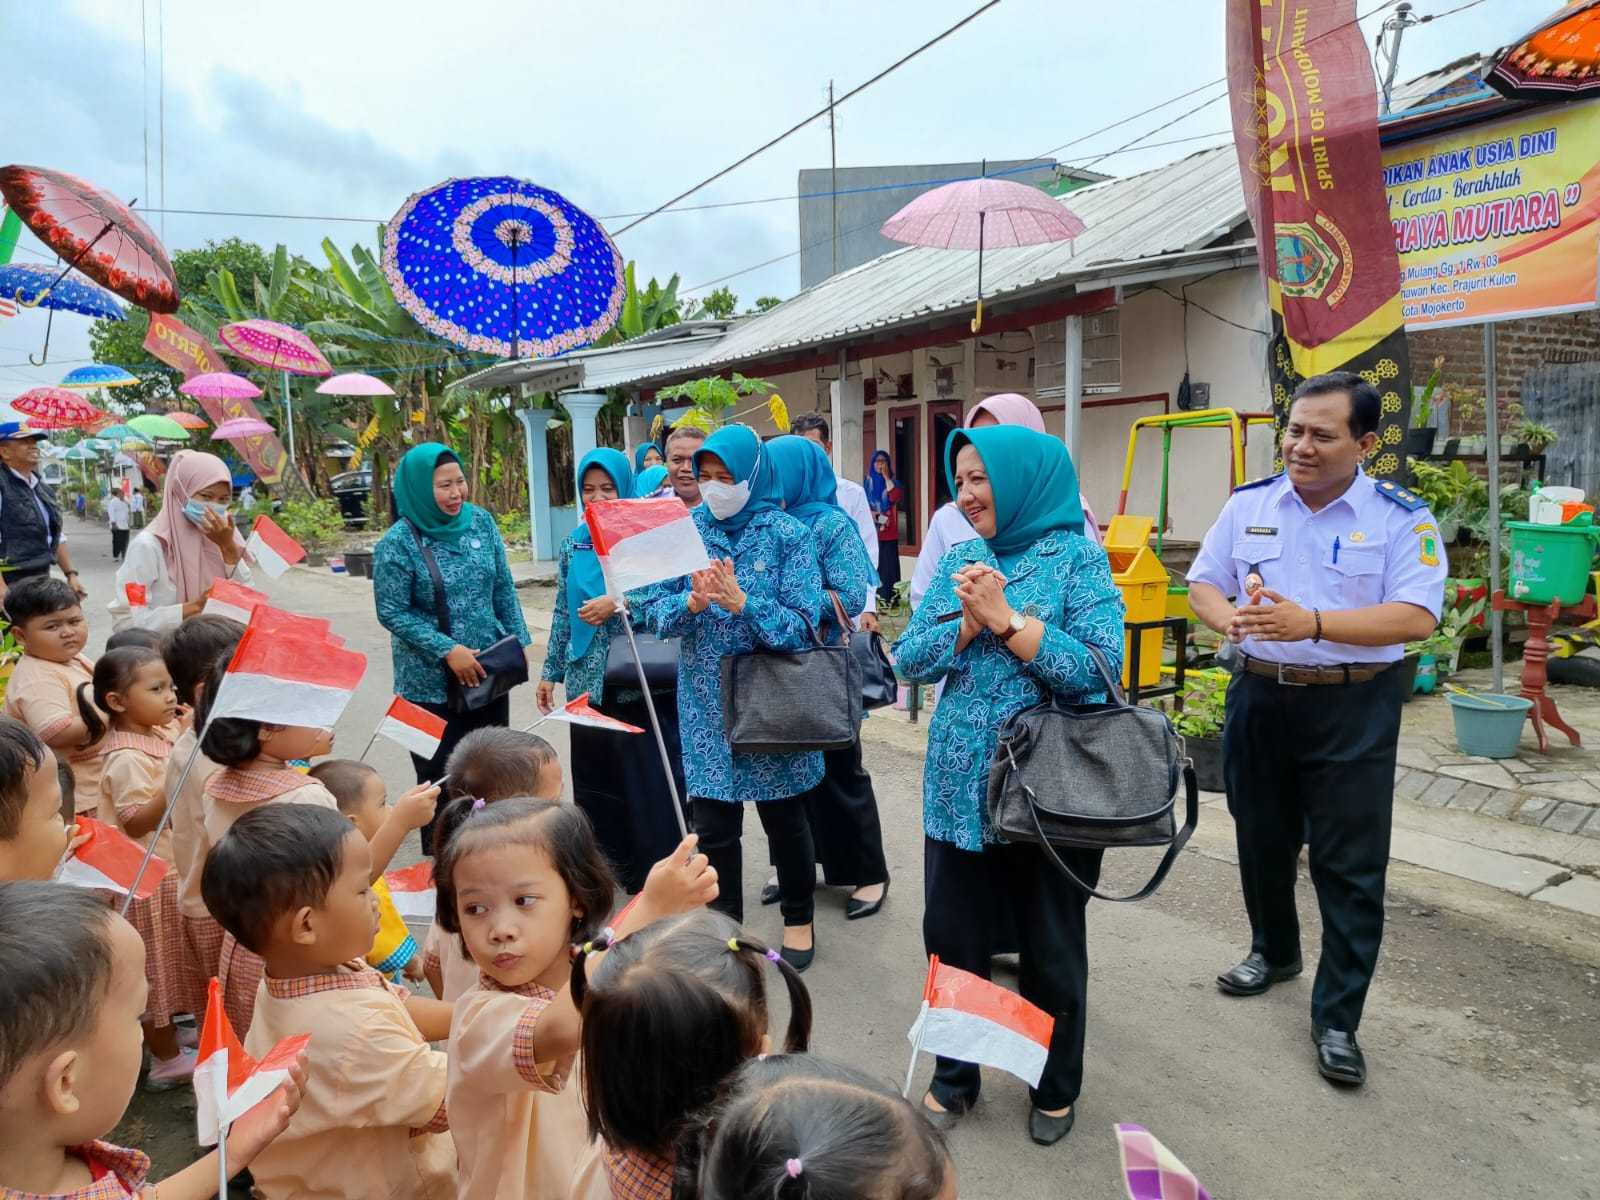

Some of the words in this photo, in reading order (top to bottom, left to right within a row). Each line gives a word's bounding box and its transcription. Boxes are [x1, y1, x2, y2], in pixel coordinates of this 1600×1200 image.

[1292, 8, 1323, 105] MOJOPAHIT
[1310, 109, 1325, 131] OF
[1311, 136, 1334, 190] SPIRIT
[1428, 150, 1471, 177] ANAK
[1476, 141, 1514, 166] USIA
[1520, 129, 1556, 157] DINI
[1403, 185, 1441, 208] Cerdas
[1454, 169, 1521, 198] Berakhlak
[1452, 190, 1561, 243] MUTIARA
[1408, 266, 1438, 280] Mulang
[1487, 255, 1498, 267] 03
[1453, 277, 1487, 295] Prajurit
[1490, 273, 1516, 286] Kulon
[1421, 300, 1465, 317] Mojokerto
